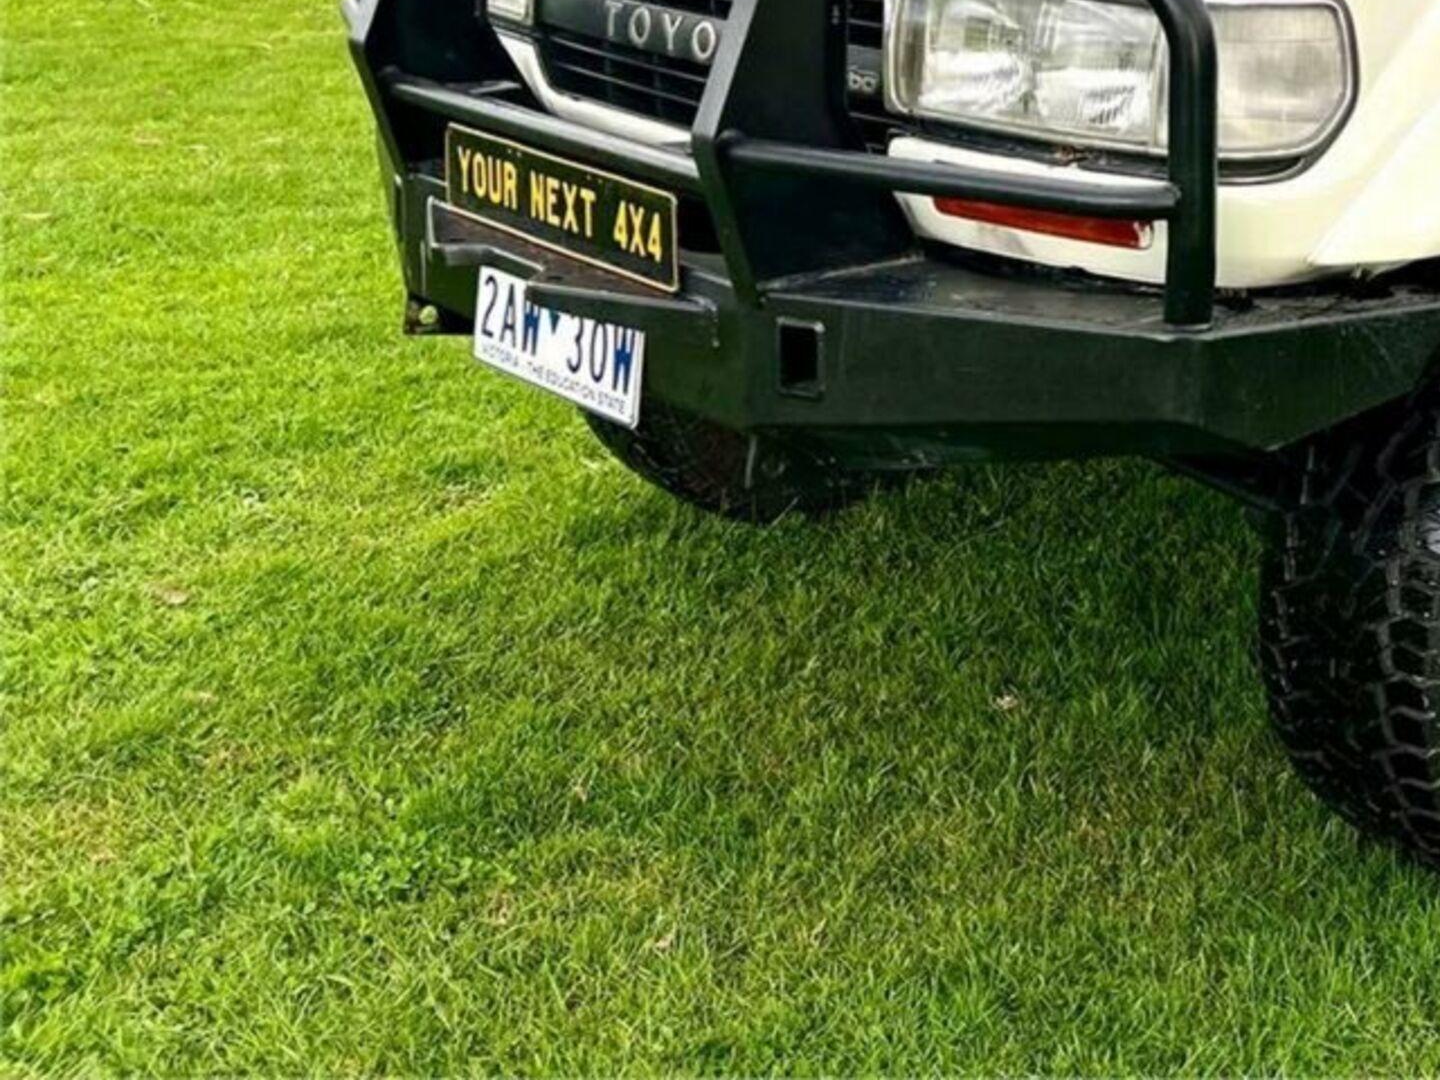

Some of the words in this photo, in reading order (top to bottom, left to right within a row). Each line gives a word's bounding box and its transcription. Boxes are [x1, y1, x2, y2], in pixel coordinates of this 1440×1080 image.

[604, 0, 716, 60] TOYO
[457, 145, 519, 211] YOUR
[529, 169, 597, 238] NEXT
[613, 199, 663, 263] 4X4
